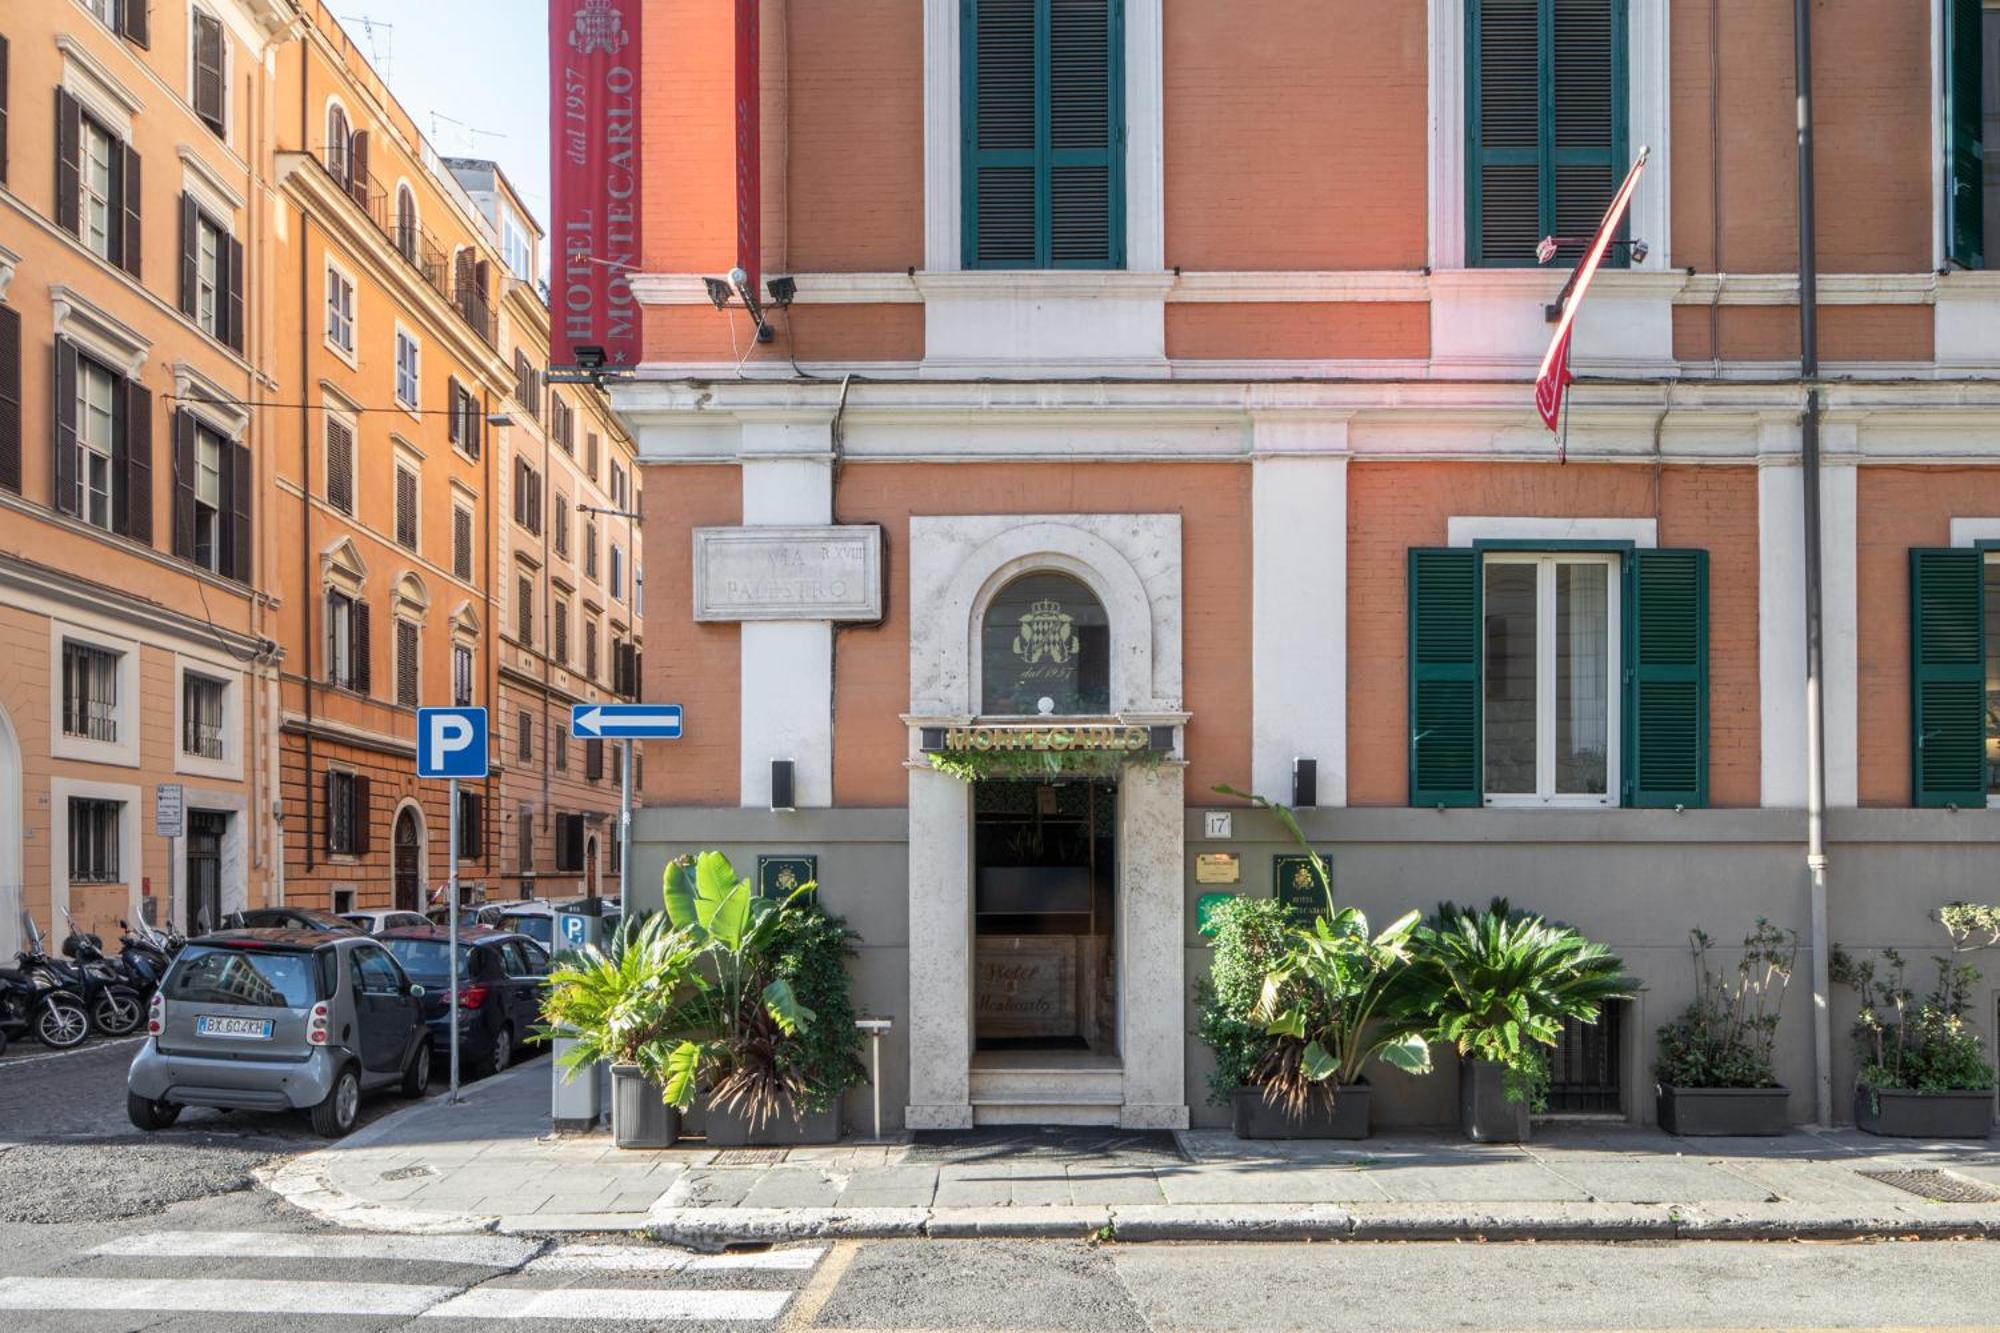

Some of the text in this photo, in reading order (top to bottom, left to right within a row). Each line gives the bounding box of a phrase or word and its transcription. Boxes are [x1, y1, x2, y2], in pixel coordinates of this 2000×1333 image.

[565, 67, 587, 166] dal 1957
[606, 65, 634, 341] MONTECARLO
[566, 208, 594, 340] HOTEL
[767, 549, 806, 568] VIA
[727, 580, 847, 600] PALESTRO
[431, 714, 474, 770] P
[950, 727, 1147, 751] MONTECARLO
[1211, 818, 1226, 833] 17
[568, 918, 582, 940] P
